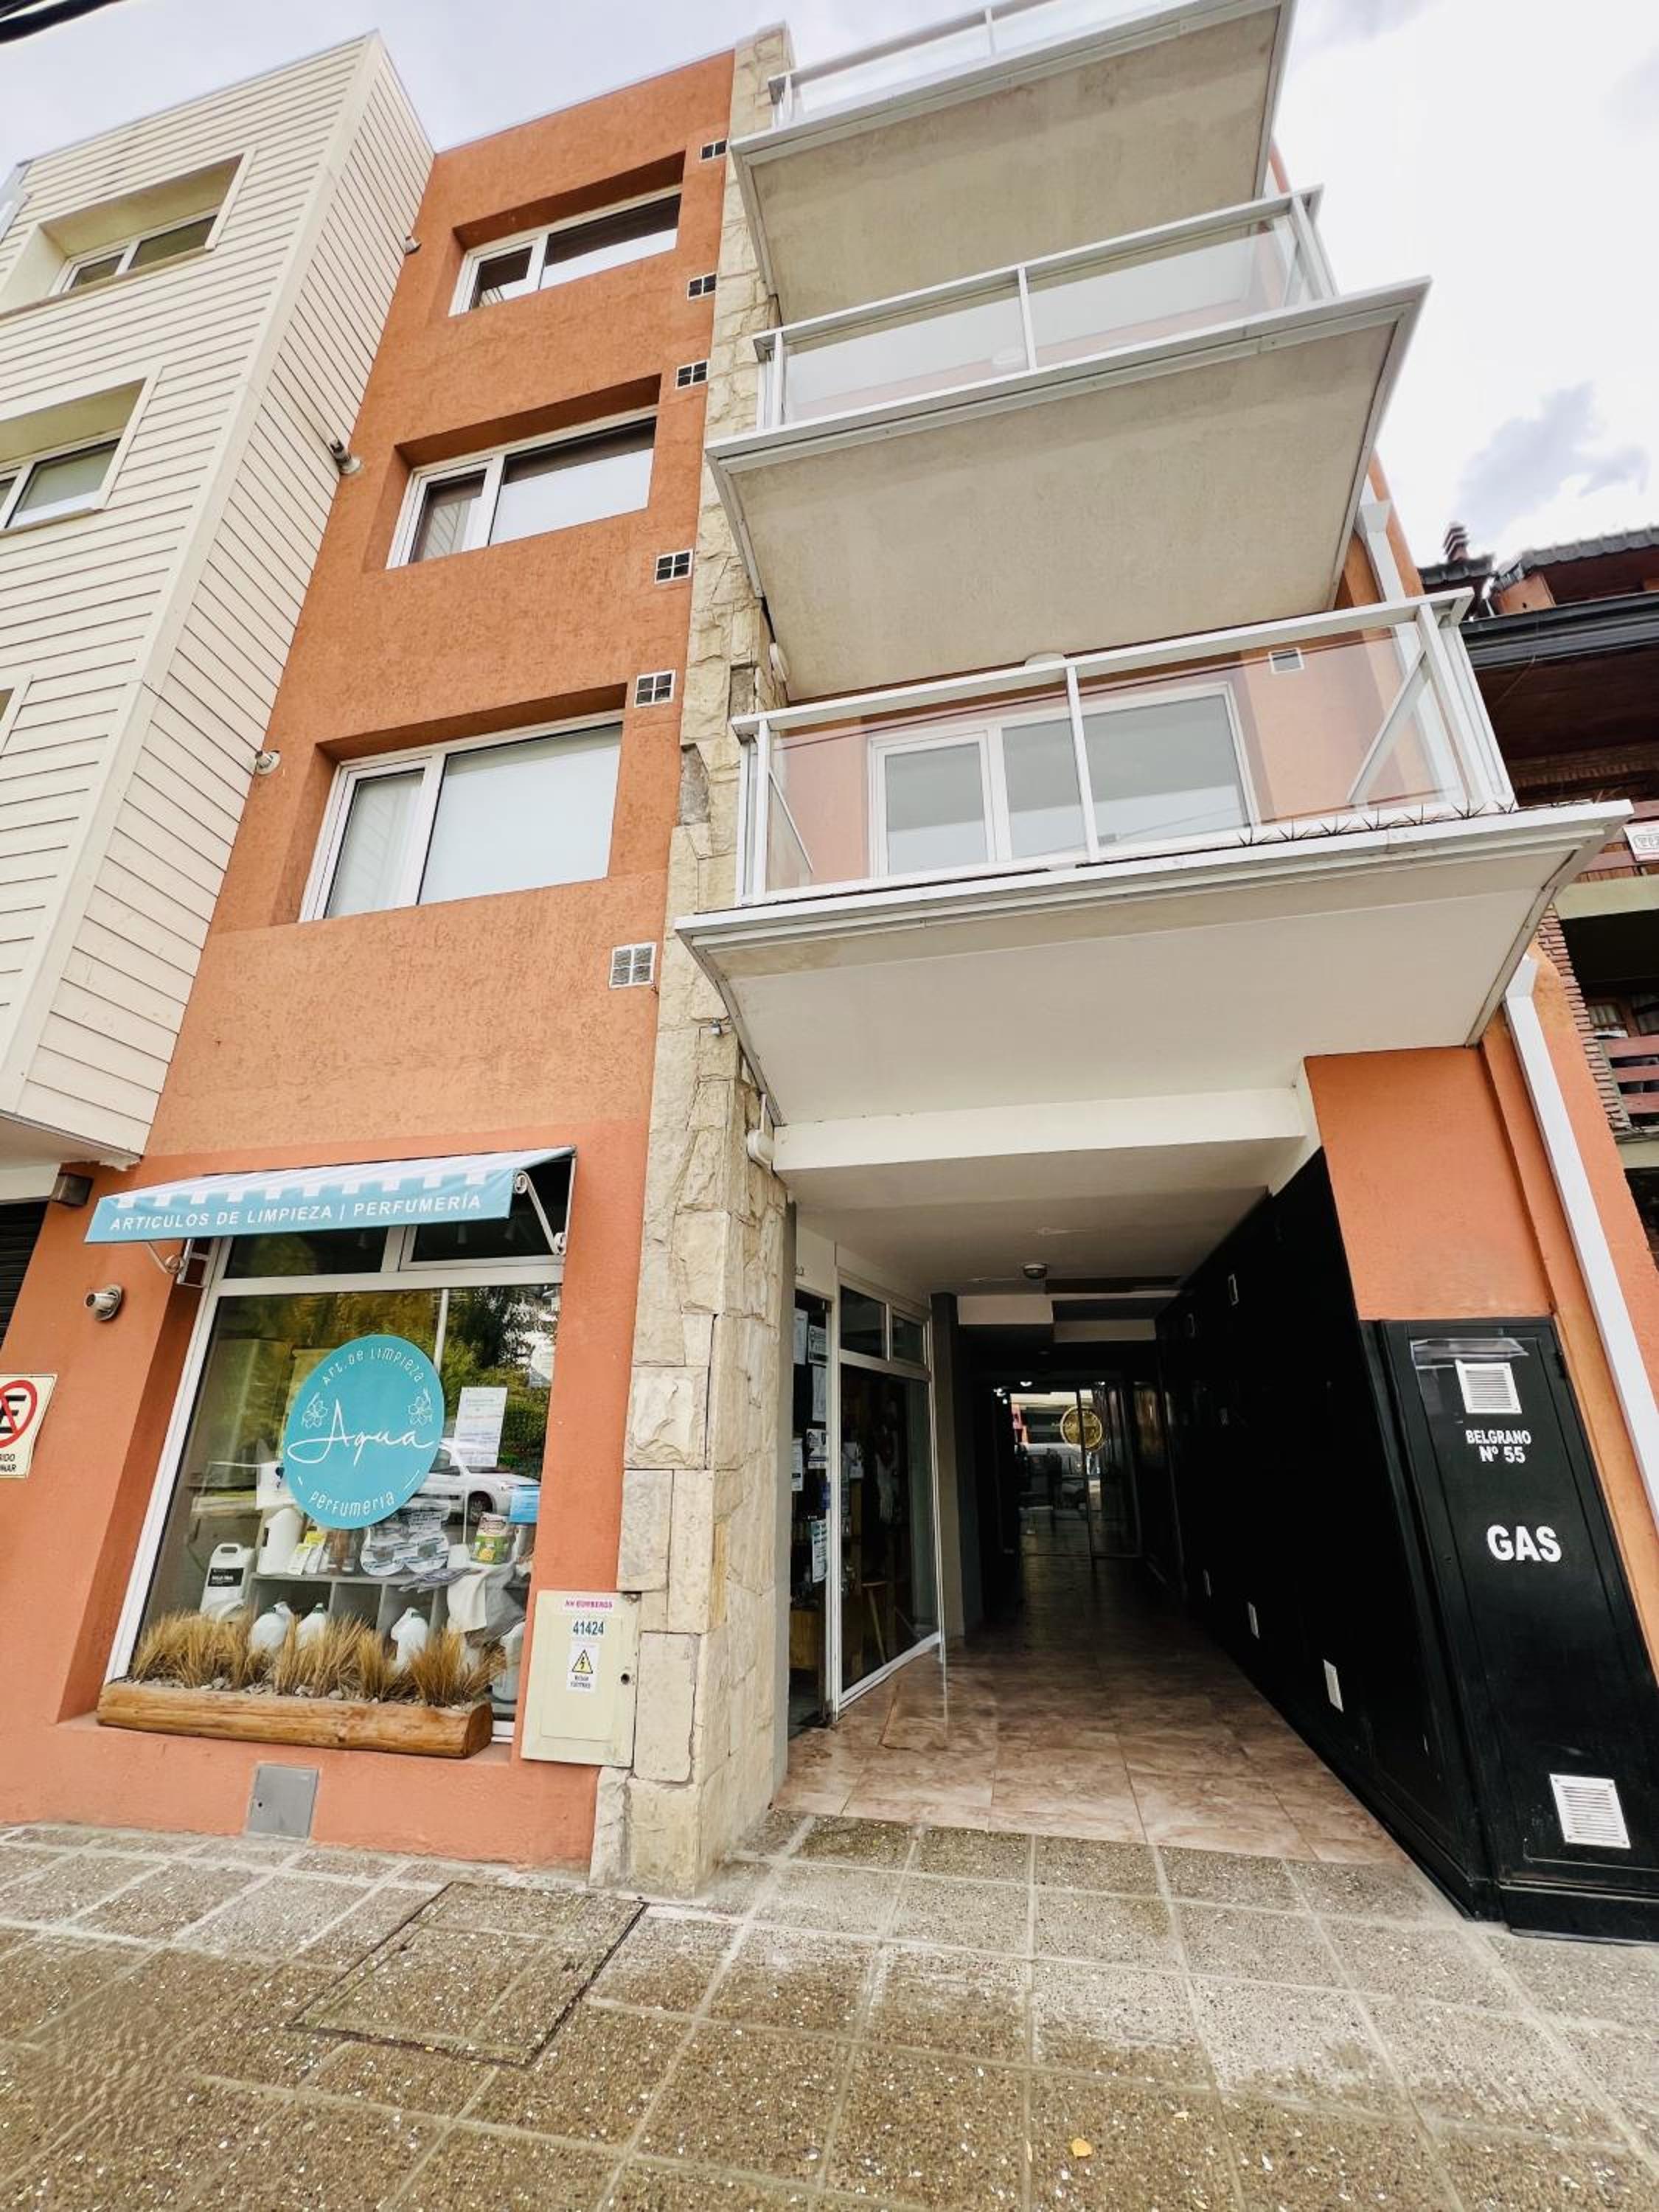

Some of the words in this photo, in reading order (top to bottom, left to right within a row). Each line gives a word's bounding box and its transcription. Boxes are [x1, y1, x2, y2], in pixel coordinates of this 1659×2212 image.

[110, 1212, 209, 1231] ARTICULOS
[217, 1210, 240, 1225] DE
[247, 1204, 333, 1225] LIMPIEZA
[287, 1398, 434, 1467] Aqua
[1465, 1429, 1531, 1444] BELGRANO
[1503, 1446, 1526, 1464] 55
[1486, 1524, 1562, 1562] GAS
[573, 1620, 605, 1635] 41424
